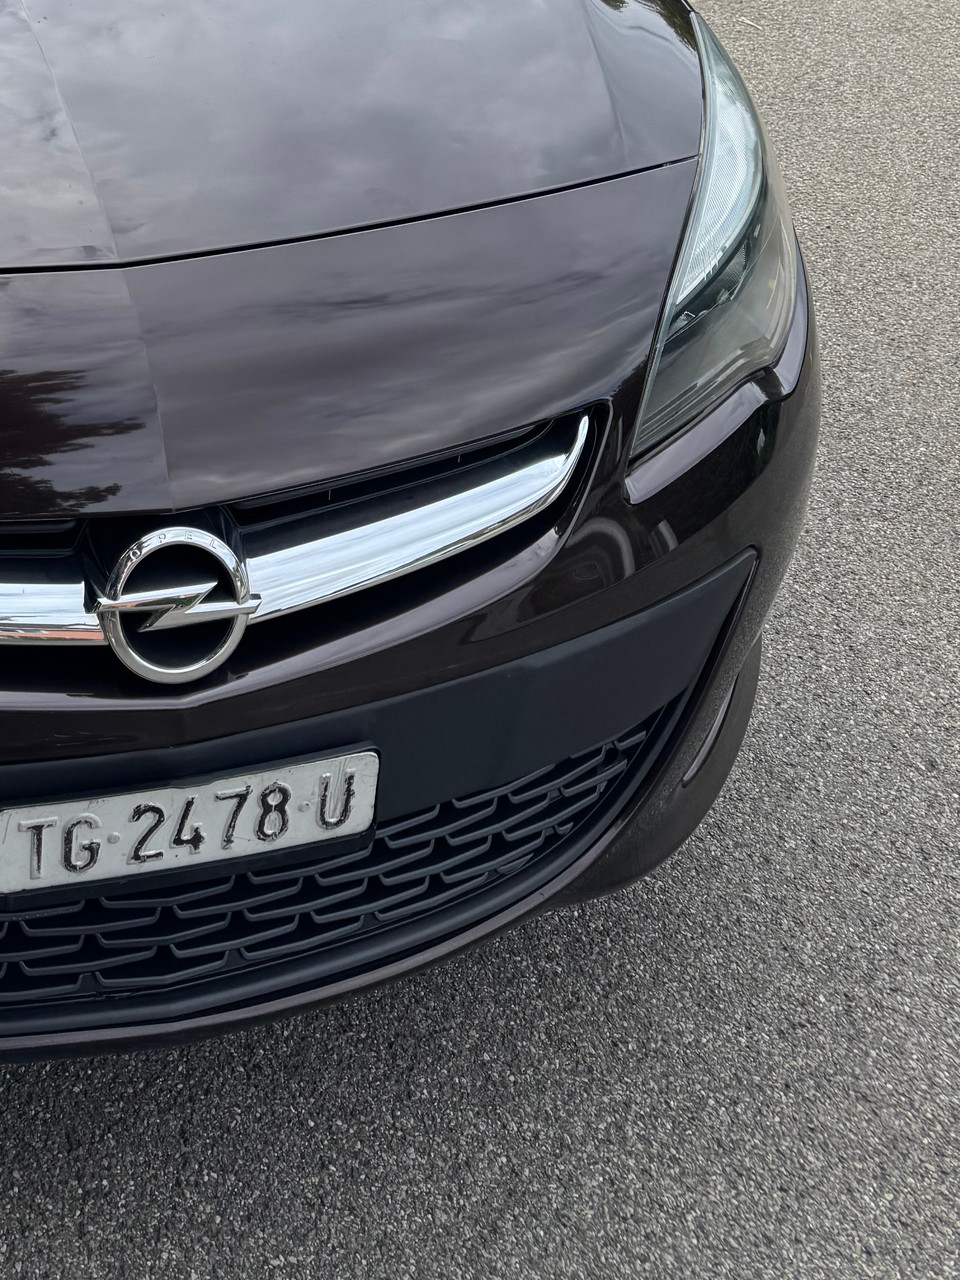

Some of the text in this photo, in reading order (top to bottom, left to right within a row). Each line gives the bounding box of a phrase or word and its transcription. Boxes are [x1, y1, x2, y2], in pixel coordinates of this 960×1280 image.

[128, 530, 218, 561] OPEL
[18, 767, 357, 879] TG 2478 U
